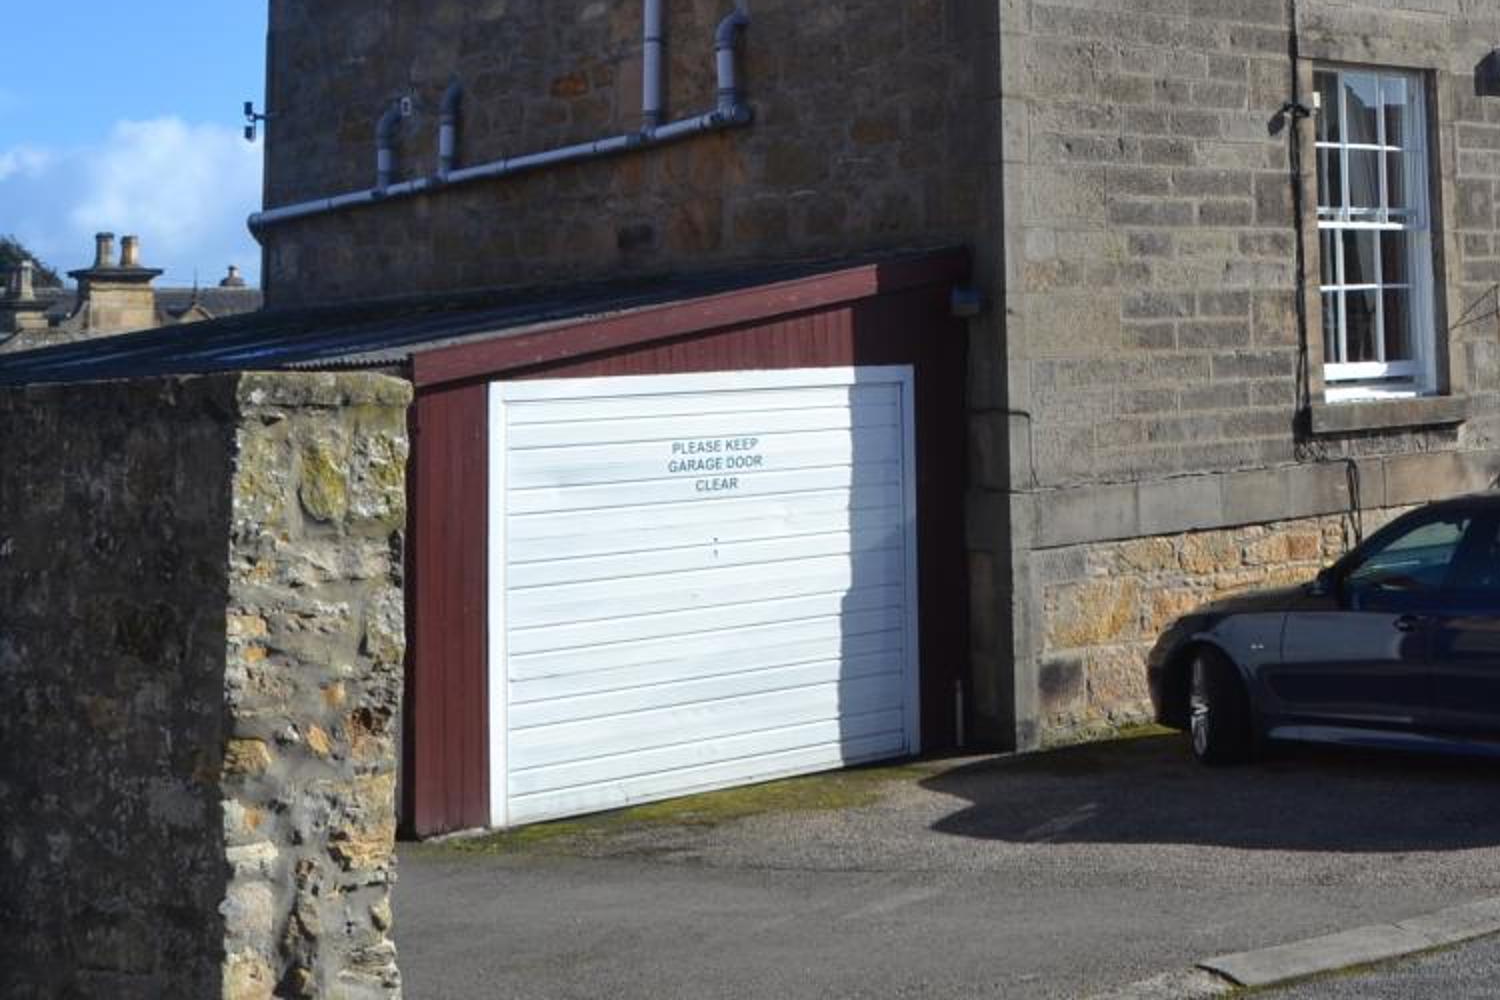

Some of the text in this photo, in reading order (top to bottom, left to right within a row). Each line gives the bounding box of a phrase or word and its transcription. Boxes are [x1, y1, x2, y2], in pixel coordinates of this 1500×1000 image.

[671, 438, 759, 455] PLEASE KEEP
[667, 455, 763, 473] GARAGE DOOR
[695, 477, 738, 492] CLEAR
